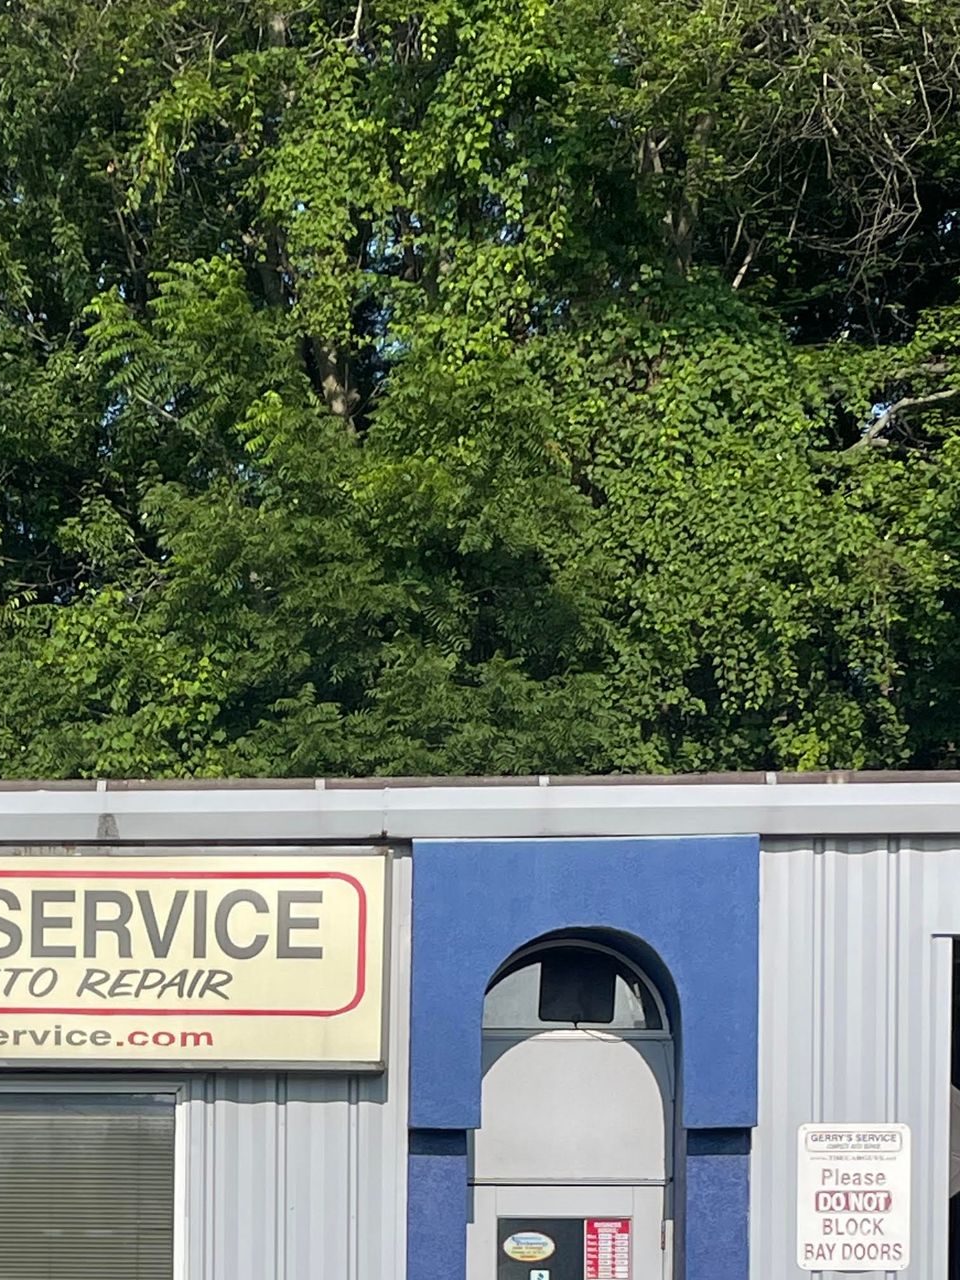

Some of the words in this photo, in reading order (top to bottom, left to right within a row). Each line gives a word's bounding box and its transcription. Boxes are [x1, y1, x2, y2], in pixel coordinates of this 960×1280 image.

[76, 968, 234, 1001] REPAIR
[810, 1133, 853, 1142] GERRY'S
[855, 1133, 897, 1143] SERVICE
[821, 1168, 887, 1186] Please
[818, 1192, 846, 1211] DO
[848, 1192, 889, 1211] NOT
[822, 1218, 885, 1236] BLOCK
[804, 1243, 837, 1260] BAY
[842, 1243, 903, 1260] DOORS
